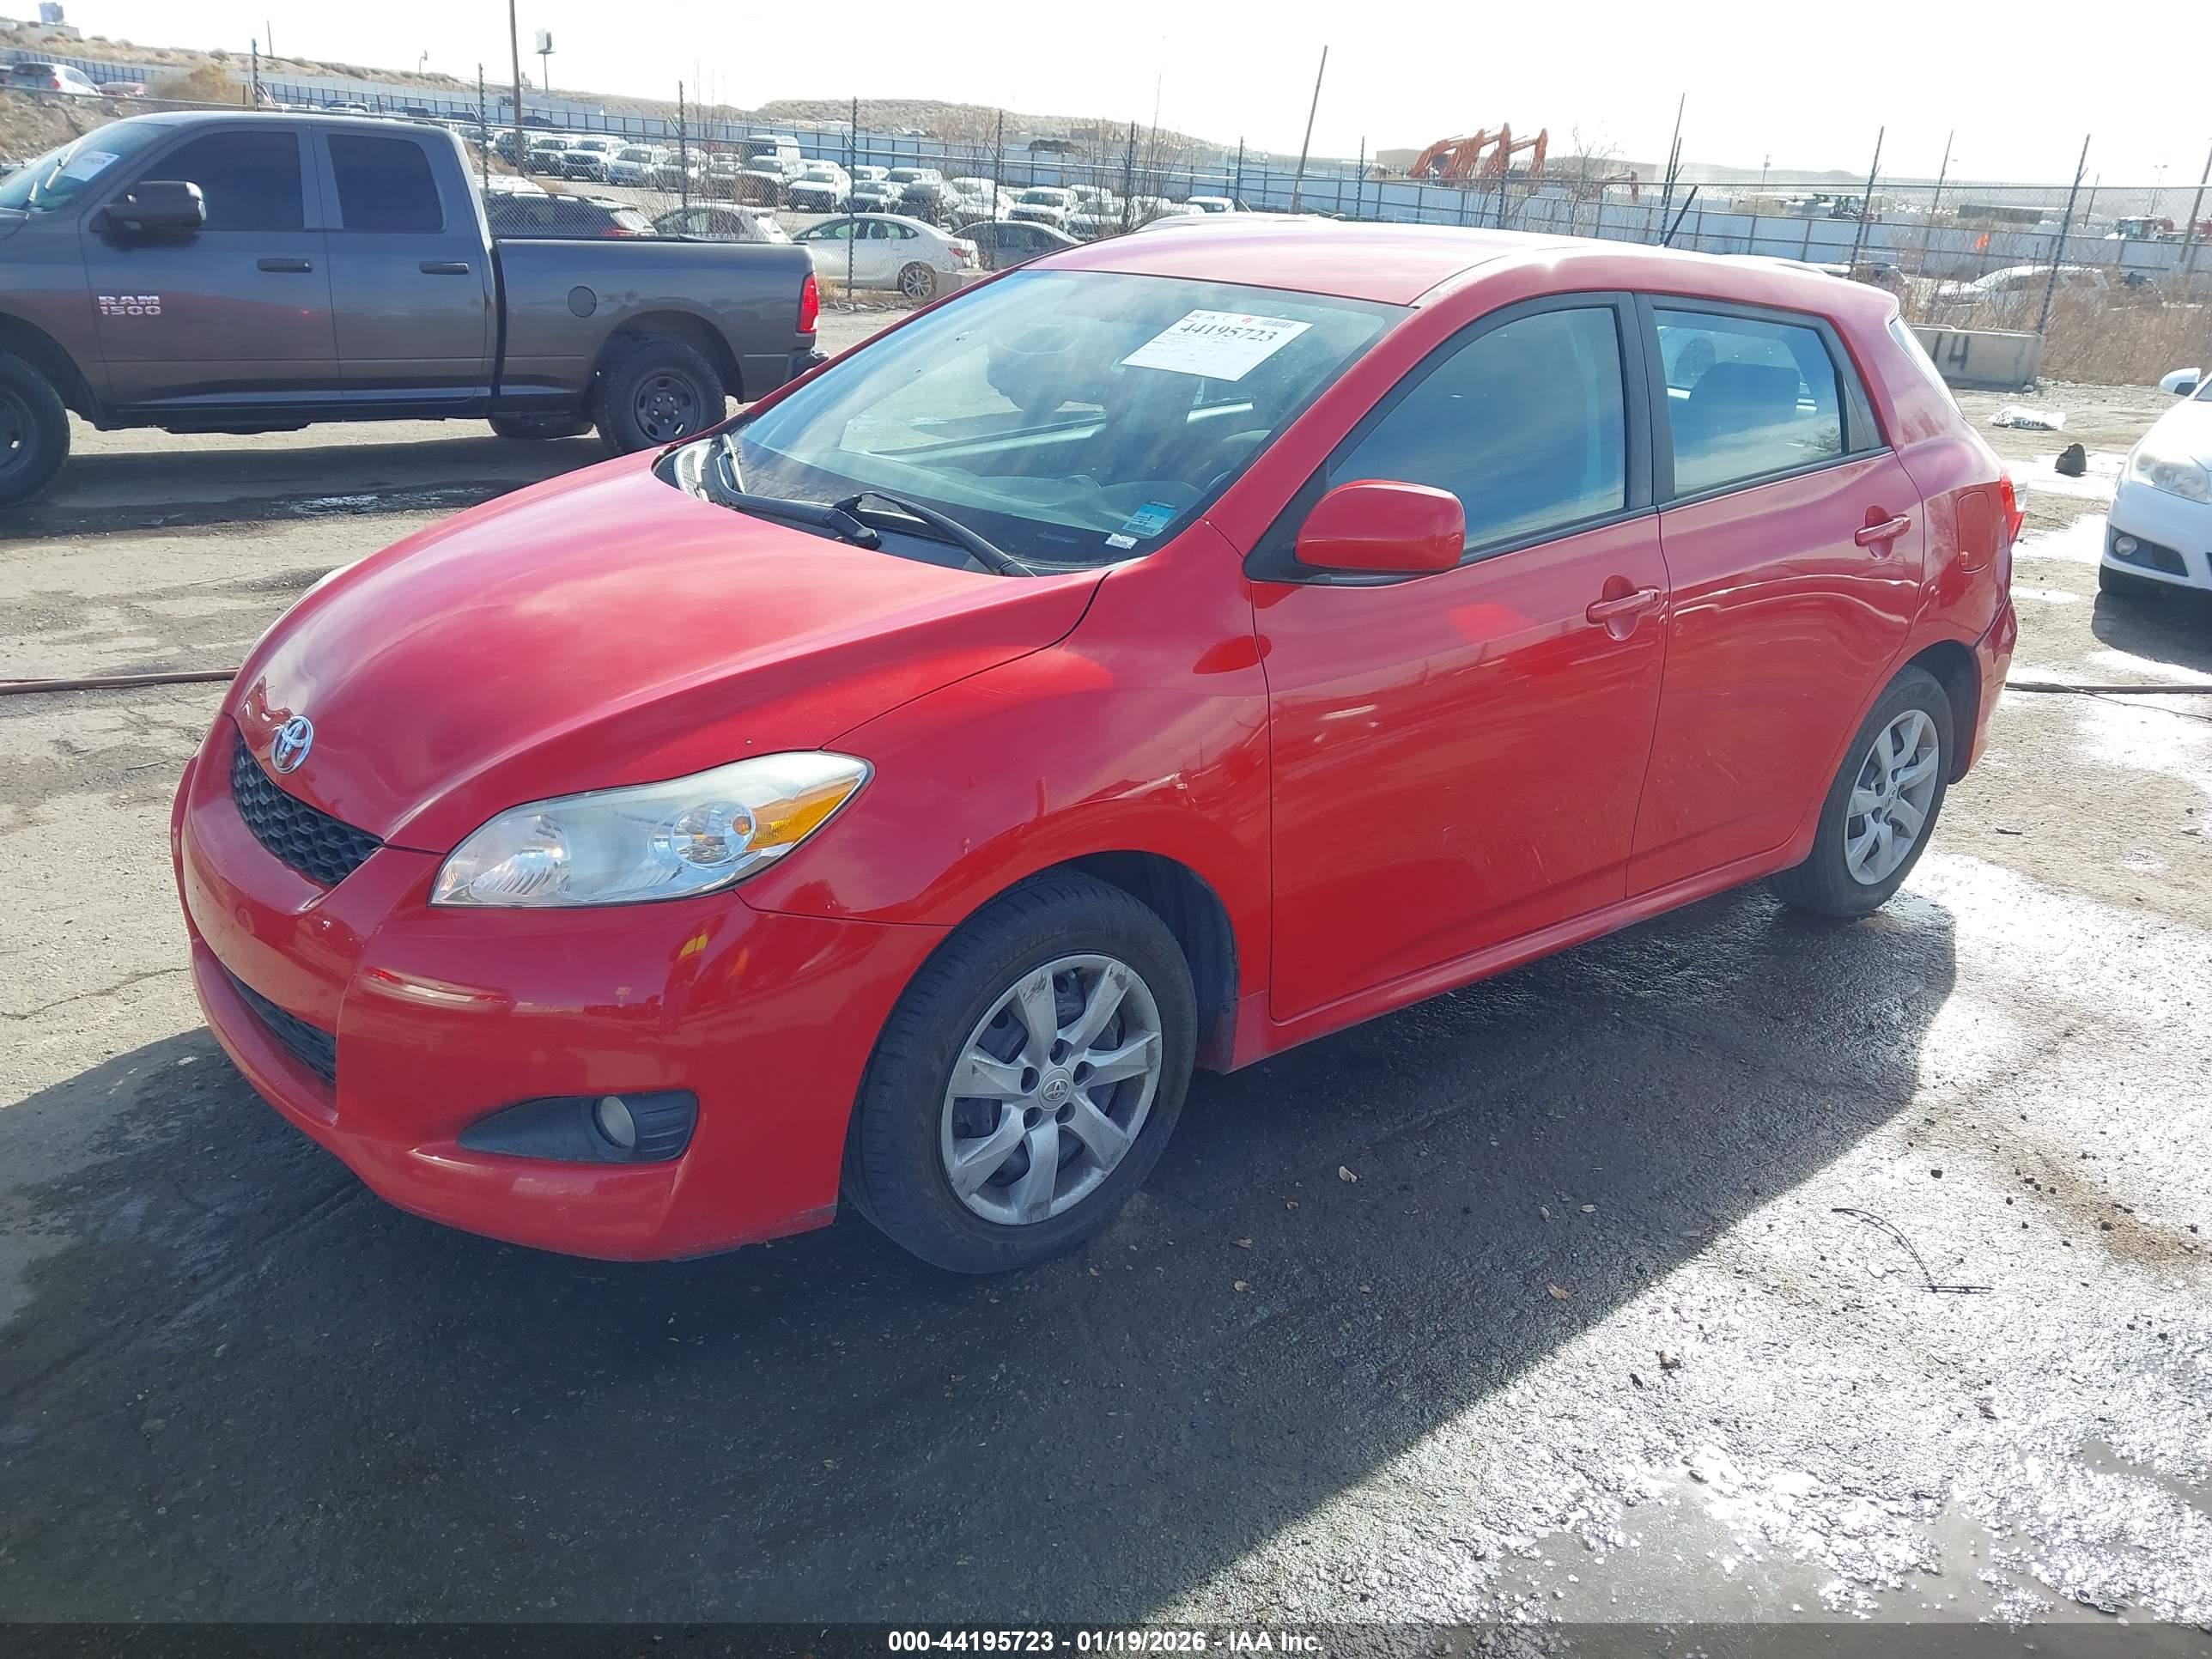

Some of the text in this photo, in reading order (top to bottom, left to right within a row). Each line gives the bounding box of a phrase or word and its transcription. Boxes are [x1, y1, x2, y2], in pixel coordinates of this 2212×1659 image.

[98, 295, 160, 305] RAM
[99, 306, 161, 315] 1500
[1181, 322, 1278, 342] 44195723
